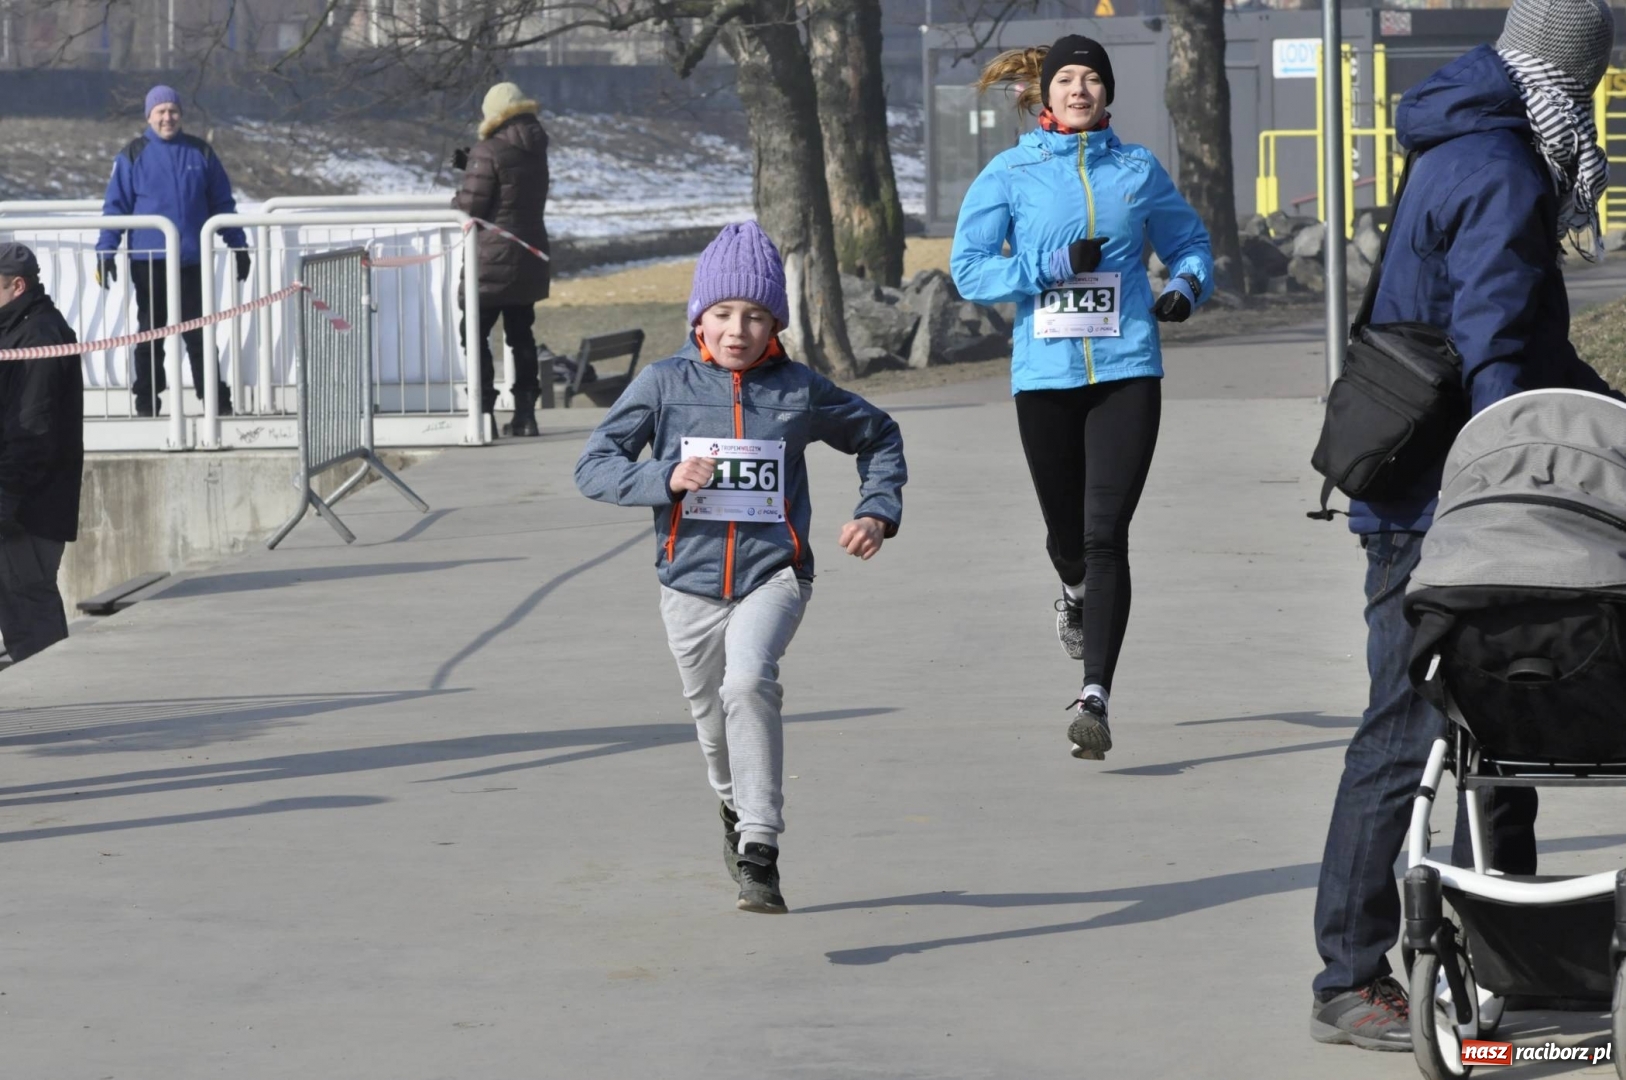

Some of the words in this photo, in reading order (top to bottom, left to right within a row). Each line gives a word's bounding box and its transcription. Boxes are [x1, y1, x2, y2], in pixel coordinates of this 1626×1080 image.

[1280, 43, 1317, 63] LODY
[1044, 289, 1112, 313] 0143
[701, 461, 776, 491] 156
